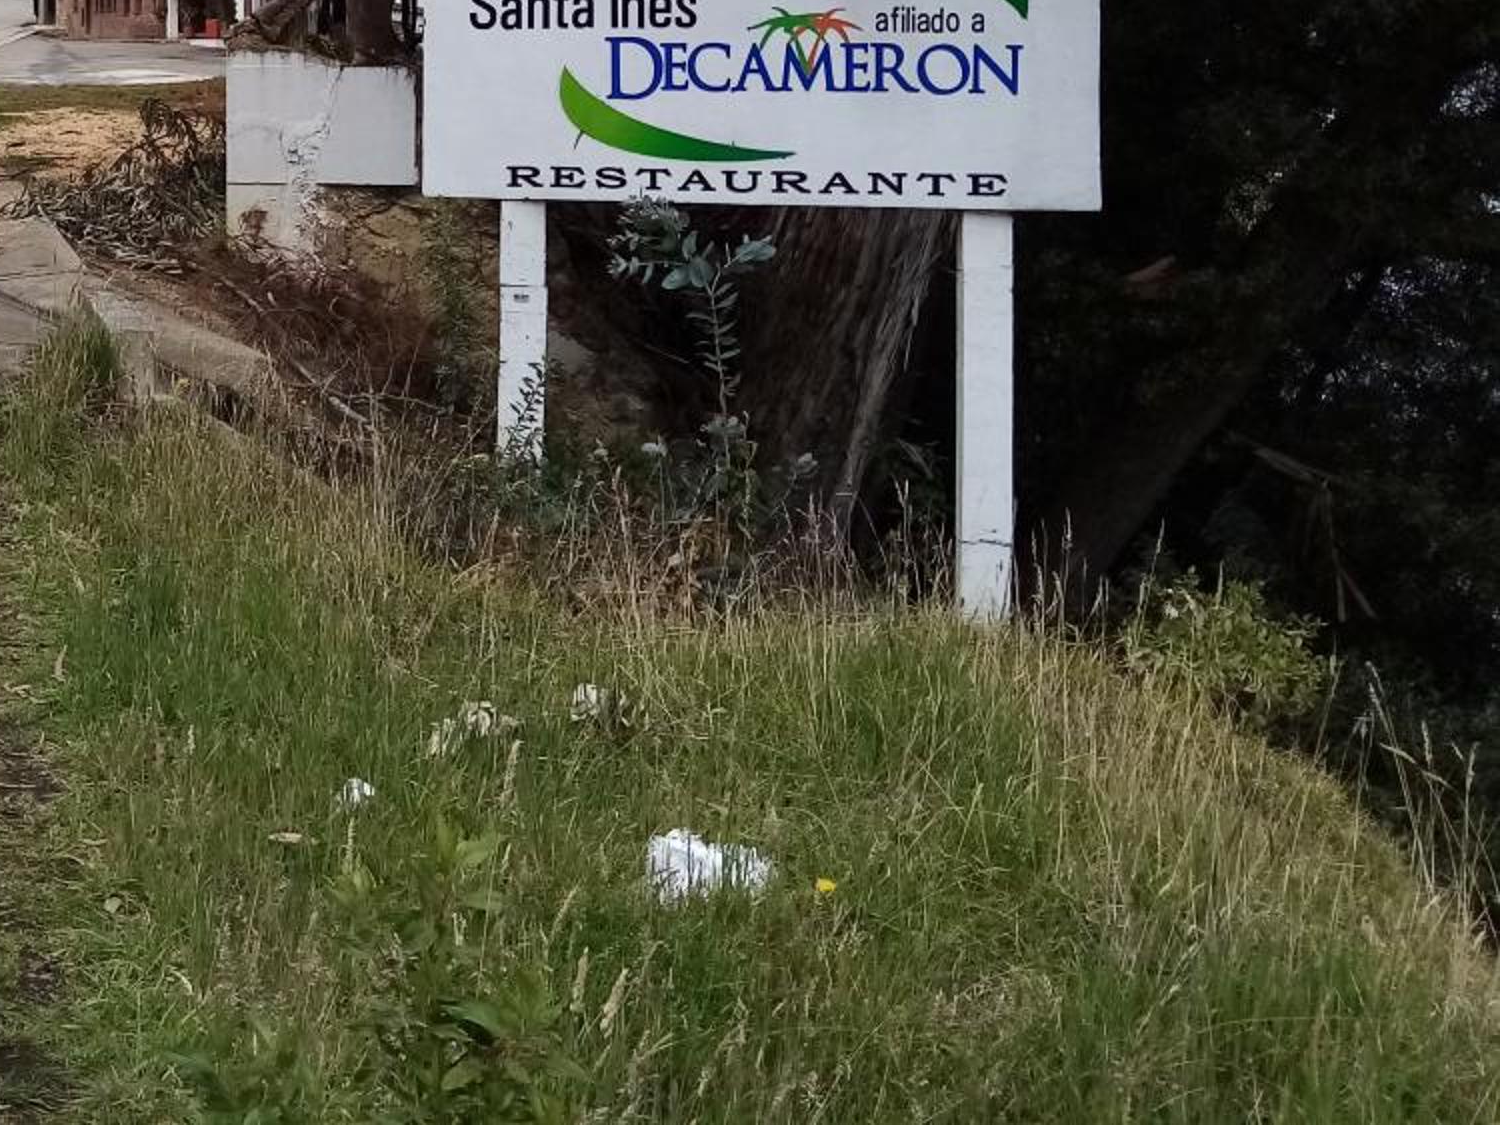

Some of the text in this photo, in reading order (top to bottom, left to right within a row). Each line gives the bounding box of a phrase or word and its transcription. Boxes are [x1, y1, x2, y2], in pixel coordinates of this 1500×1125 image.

[875, 5, 985, 34] afiliado a
[604, 36, 1024, 100] DECAMERON
[506, 165, 1008, 197] RESTAURANTE
